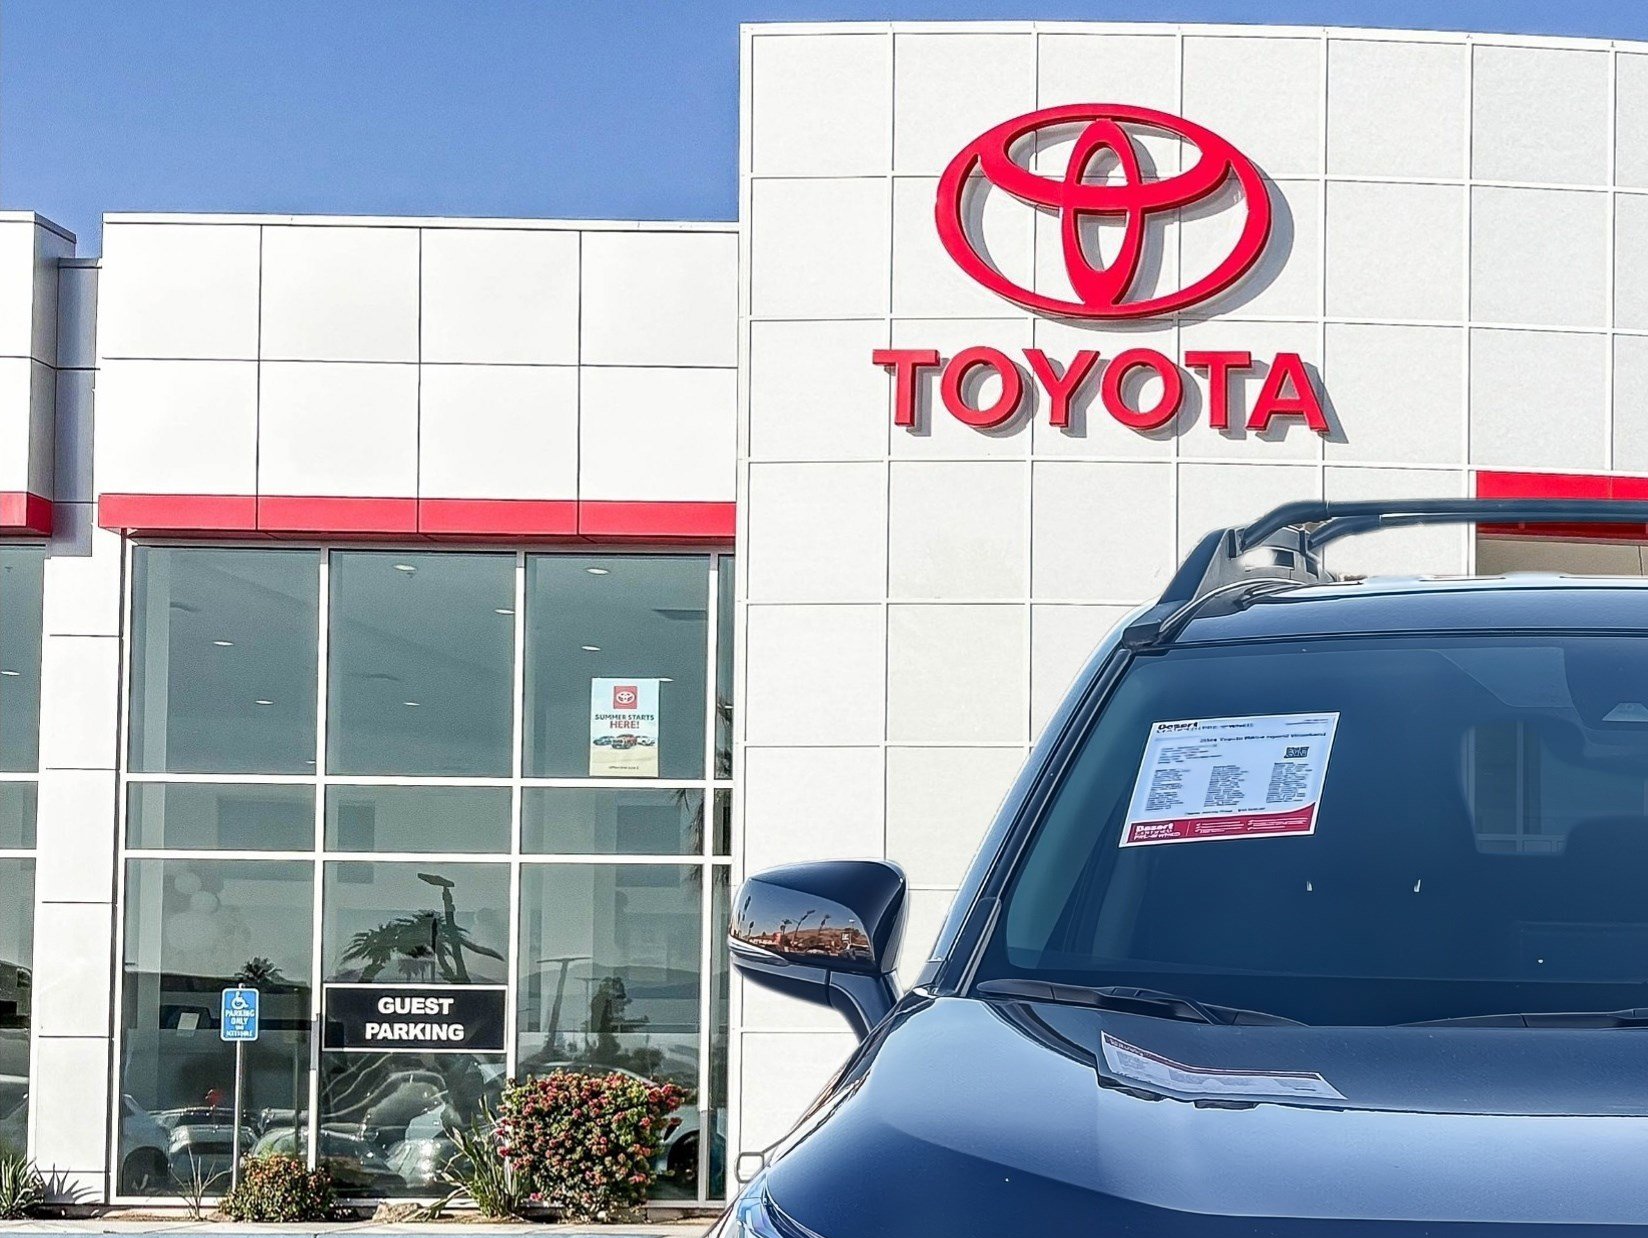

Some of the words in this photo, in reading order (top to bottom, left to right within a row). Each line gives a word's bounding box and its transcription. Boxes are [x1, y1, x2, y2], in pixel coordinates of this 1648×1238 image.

[872, 346, 1329, 433] TOYOTA
[609, 721, 639, 729] HERE!
[378, 997, 454, 1015] GUEST
[225, 1009, 255, 1017] PARKING
[230, 1017, 249, 1025] ONLY
[365, 1023, 464, 1041] PARKING
